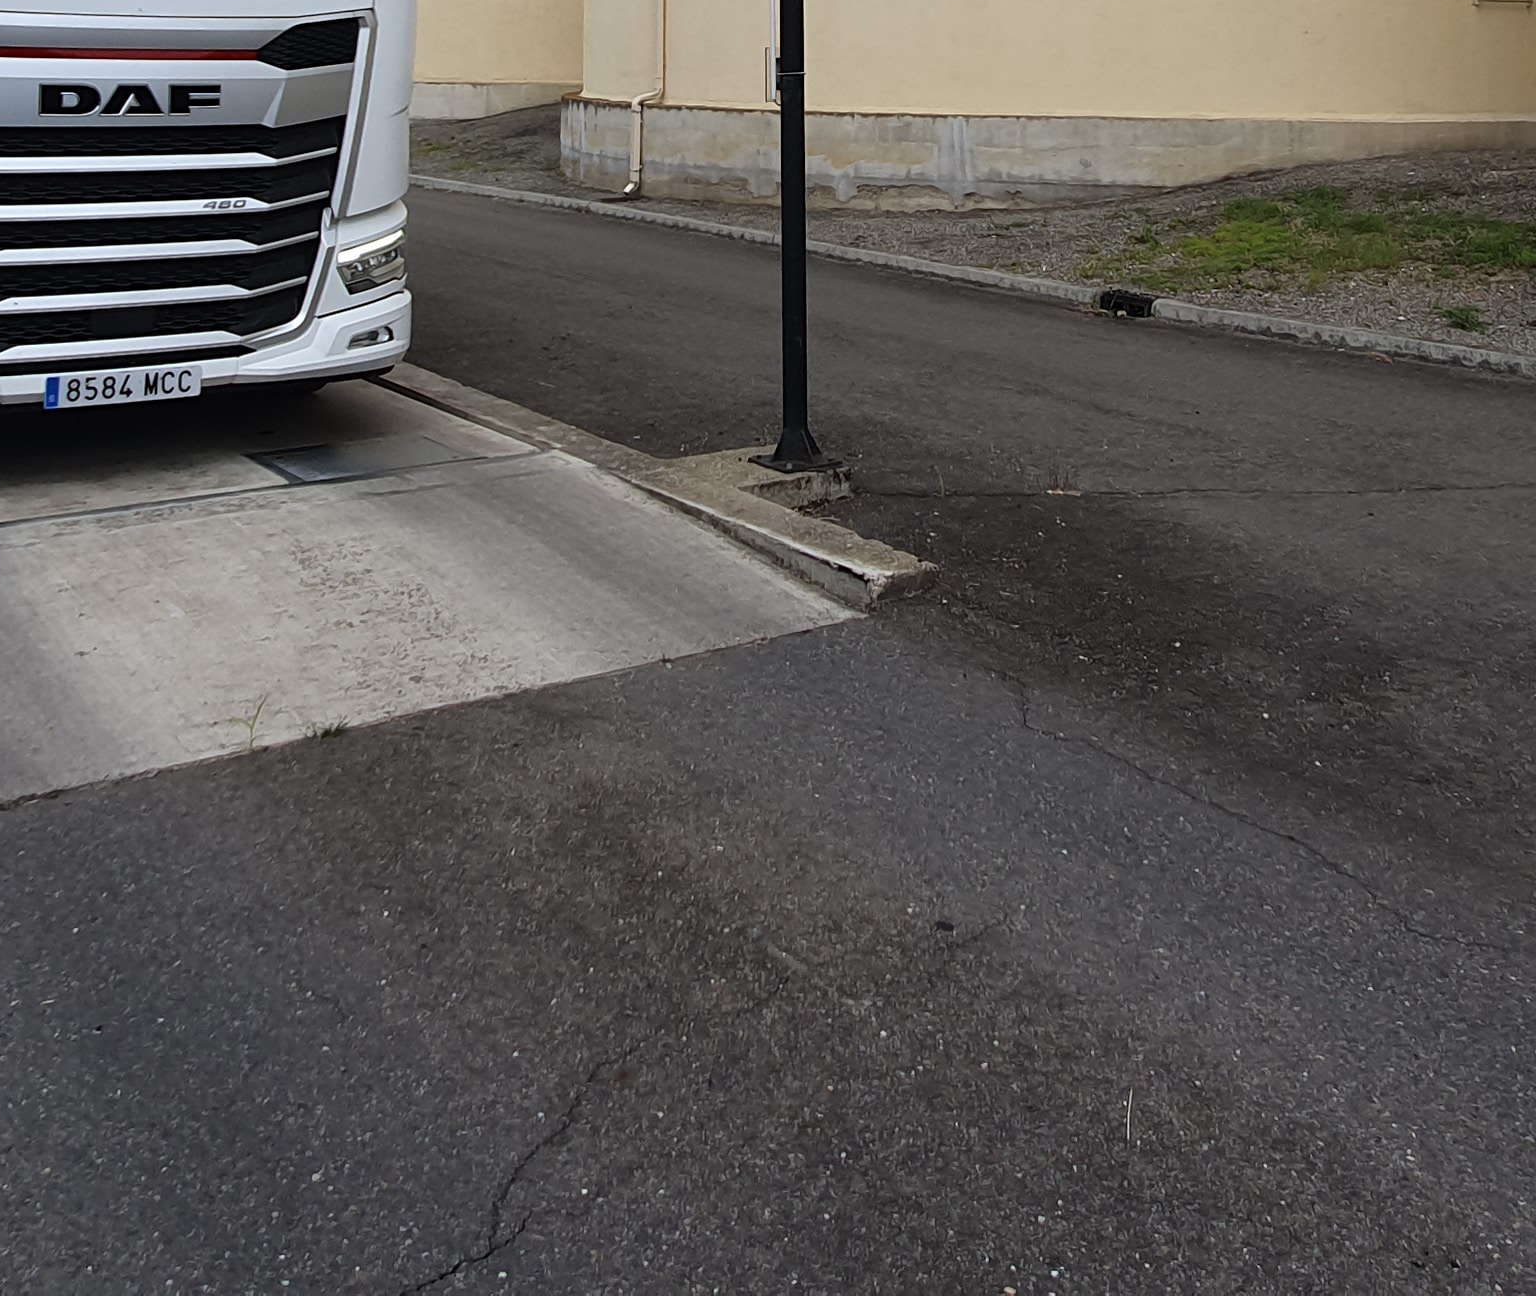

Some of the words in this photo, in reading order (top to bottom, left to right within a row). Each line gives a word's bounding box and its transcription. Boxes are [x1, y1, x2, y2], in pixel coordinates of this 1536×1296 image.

[38, 83, 222, 117] DAF
[202, 199, 247, 210] 480
[66, 374, 133, 402] 8584
[144, 370, 192, 396] MCC
